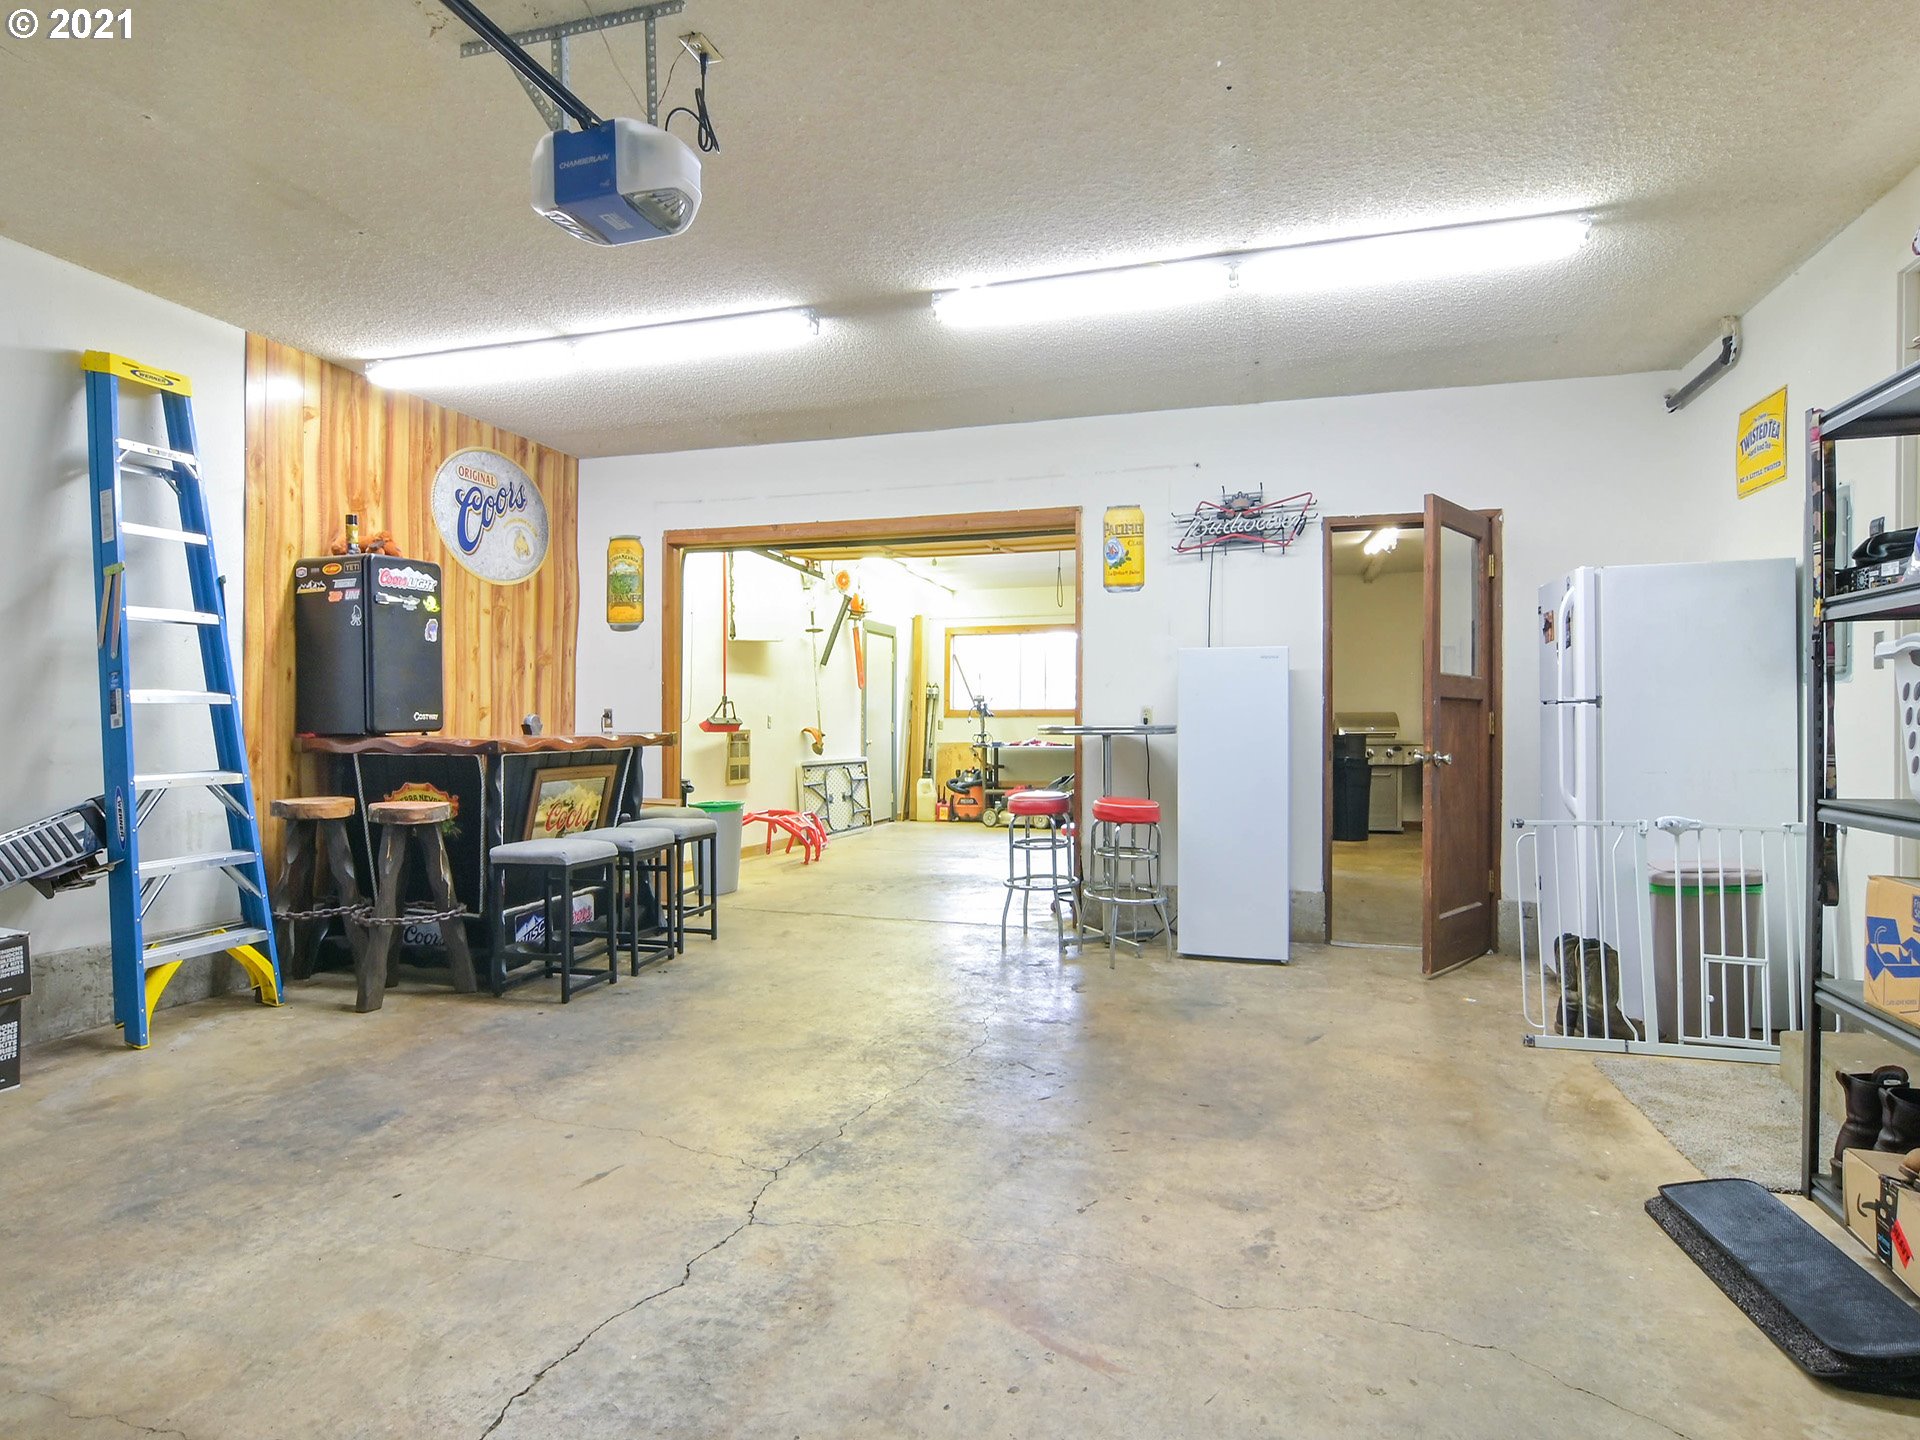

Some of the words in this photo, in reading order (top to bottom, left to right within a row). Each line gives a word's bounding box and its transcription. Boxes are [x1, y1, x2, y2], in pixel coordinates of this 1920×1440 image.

[559, 154, 610, 169] CHAMBERLAIN
[139, 372, 166, 383] WERNER
[1740, 422, 1768, 455] TWISTED
[1768, 419, 1780, 440] TEA
[458, 466, 495, 487] ORIGINAL
[455, 482, 526, 552] Coors
[1184, 511, 1305, 539] Budweiser
[345, 563, 360, 571] YETI
[379, 569, 407, 587] Coors
[407, 576, 436, 592] LIGHT
[117, 800, 125, 837] WERNER
[545, 800, 590, 832] Coors
